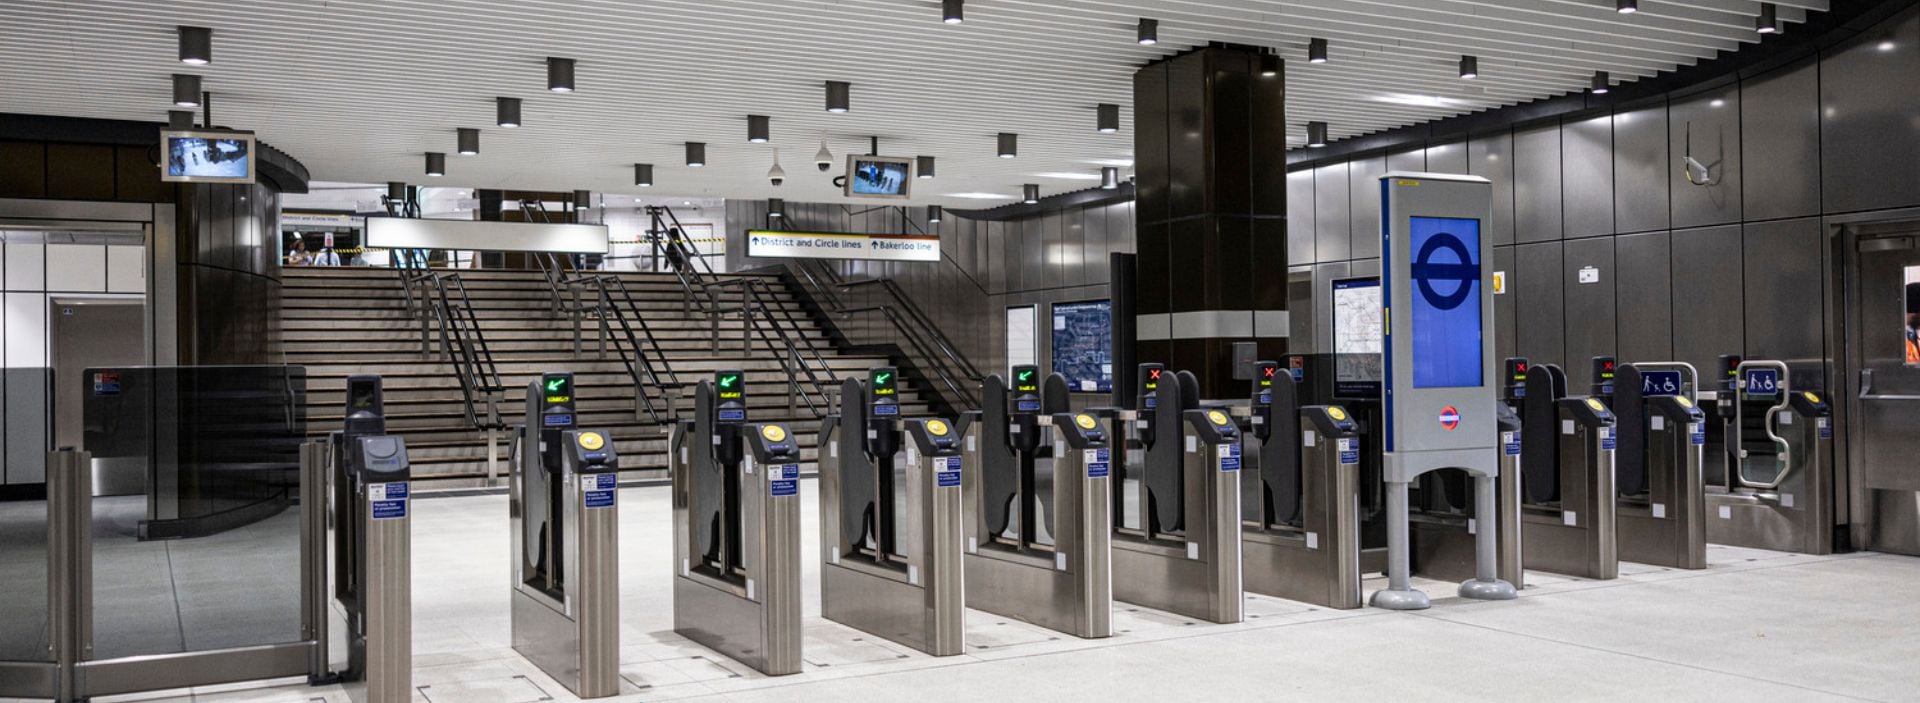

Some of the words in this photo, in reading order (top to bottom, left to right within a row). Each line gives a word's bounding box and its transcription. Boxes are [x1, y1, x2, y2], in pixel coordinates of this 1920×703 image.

[761, 237, 794, 247] District
[796, 239, 812, 247] and
[815, 238, 839, 248] Circle
[842, 240, 862, 249] lines
[880, 241, 915, 250] Bakerloo
[917, 242, 931, 251] line
